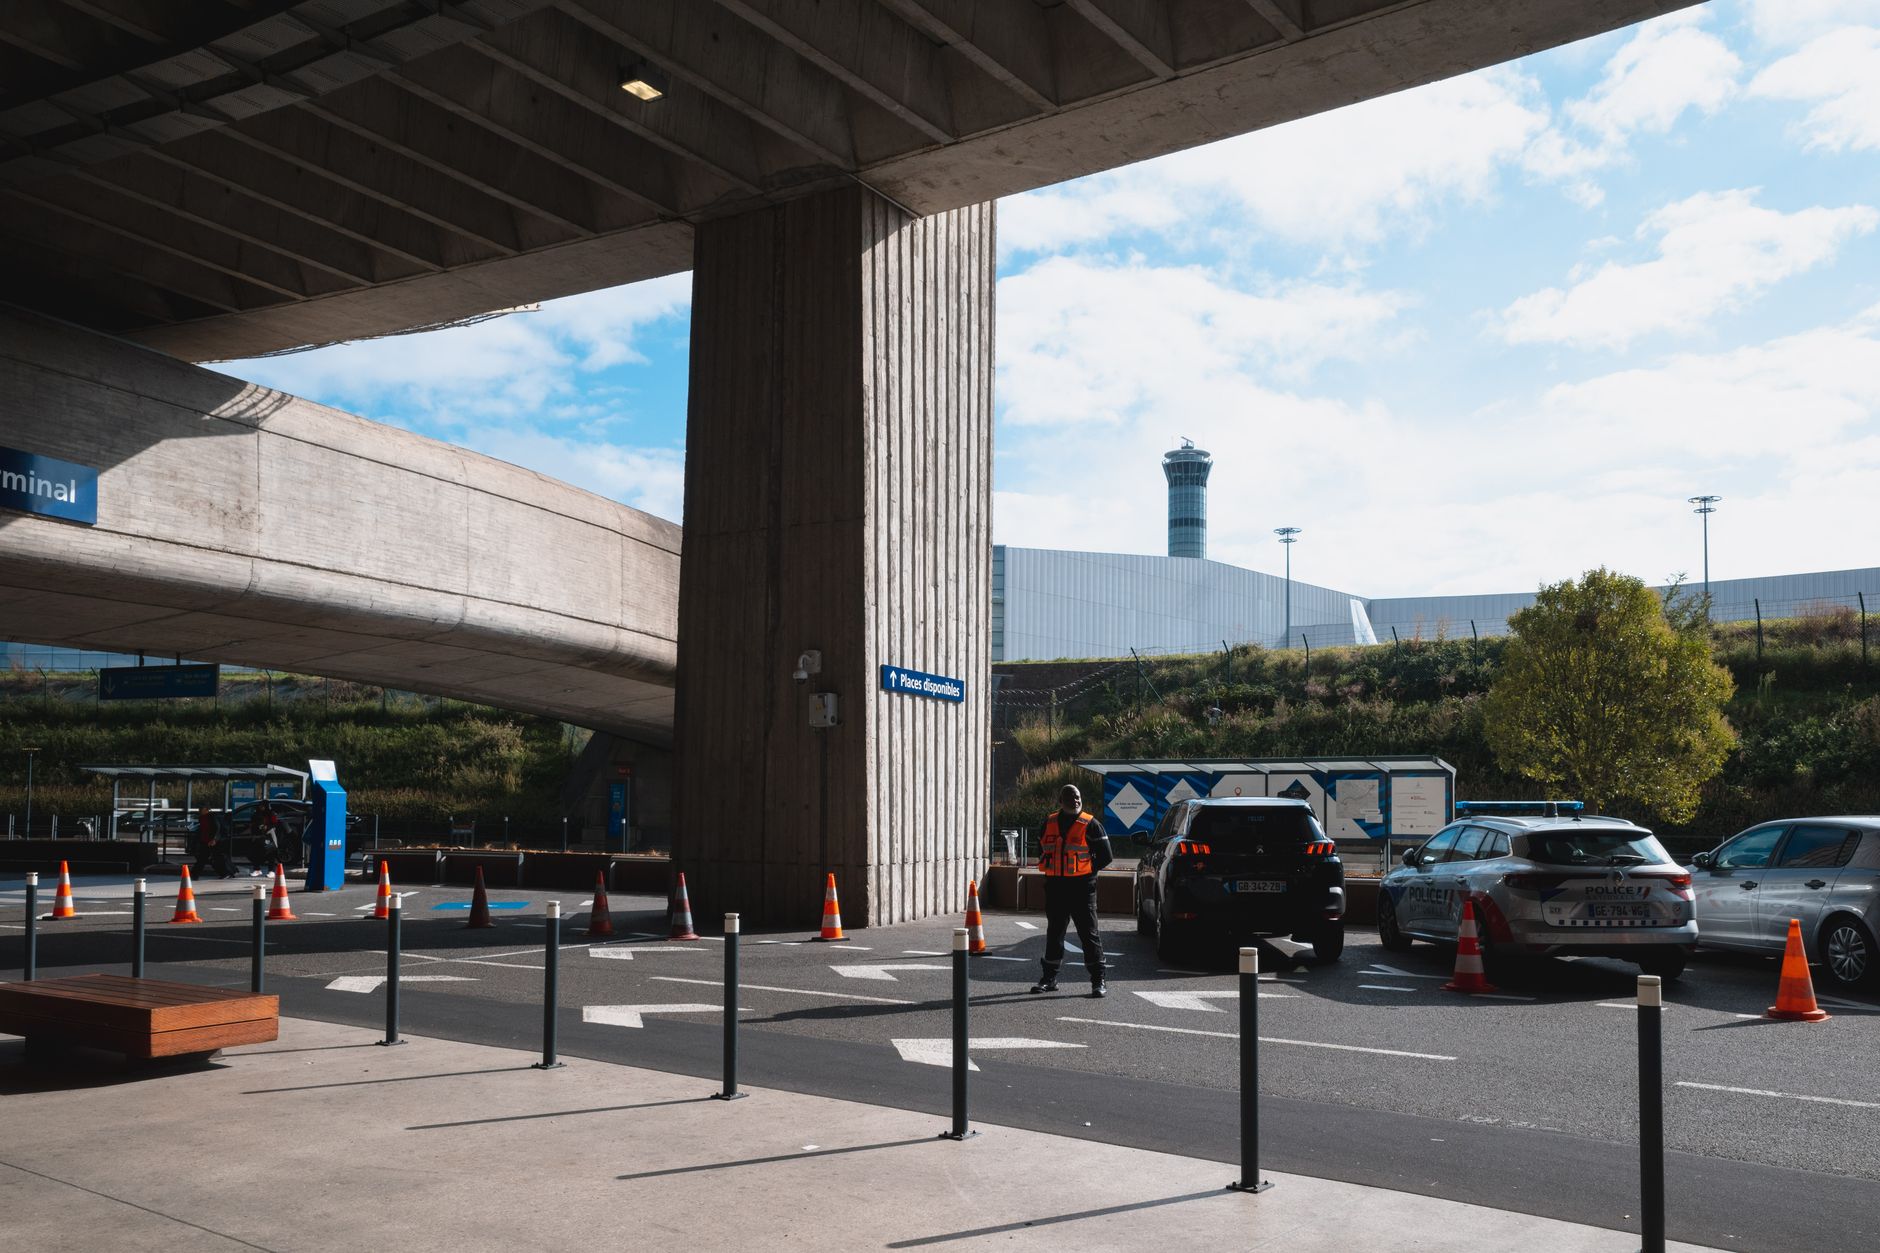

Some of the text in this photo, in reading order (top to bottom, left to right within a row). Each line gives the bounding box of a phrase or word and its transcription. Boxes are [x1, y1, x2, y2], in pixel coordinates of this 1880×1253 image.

[0, 469, 76, 504] minal
[900, 673, 960, 697] Places disponibles
[1409, 886, 1443, 905] POLICE
[1584, 886, 1636, 895] POLICE
